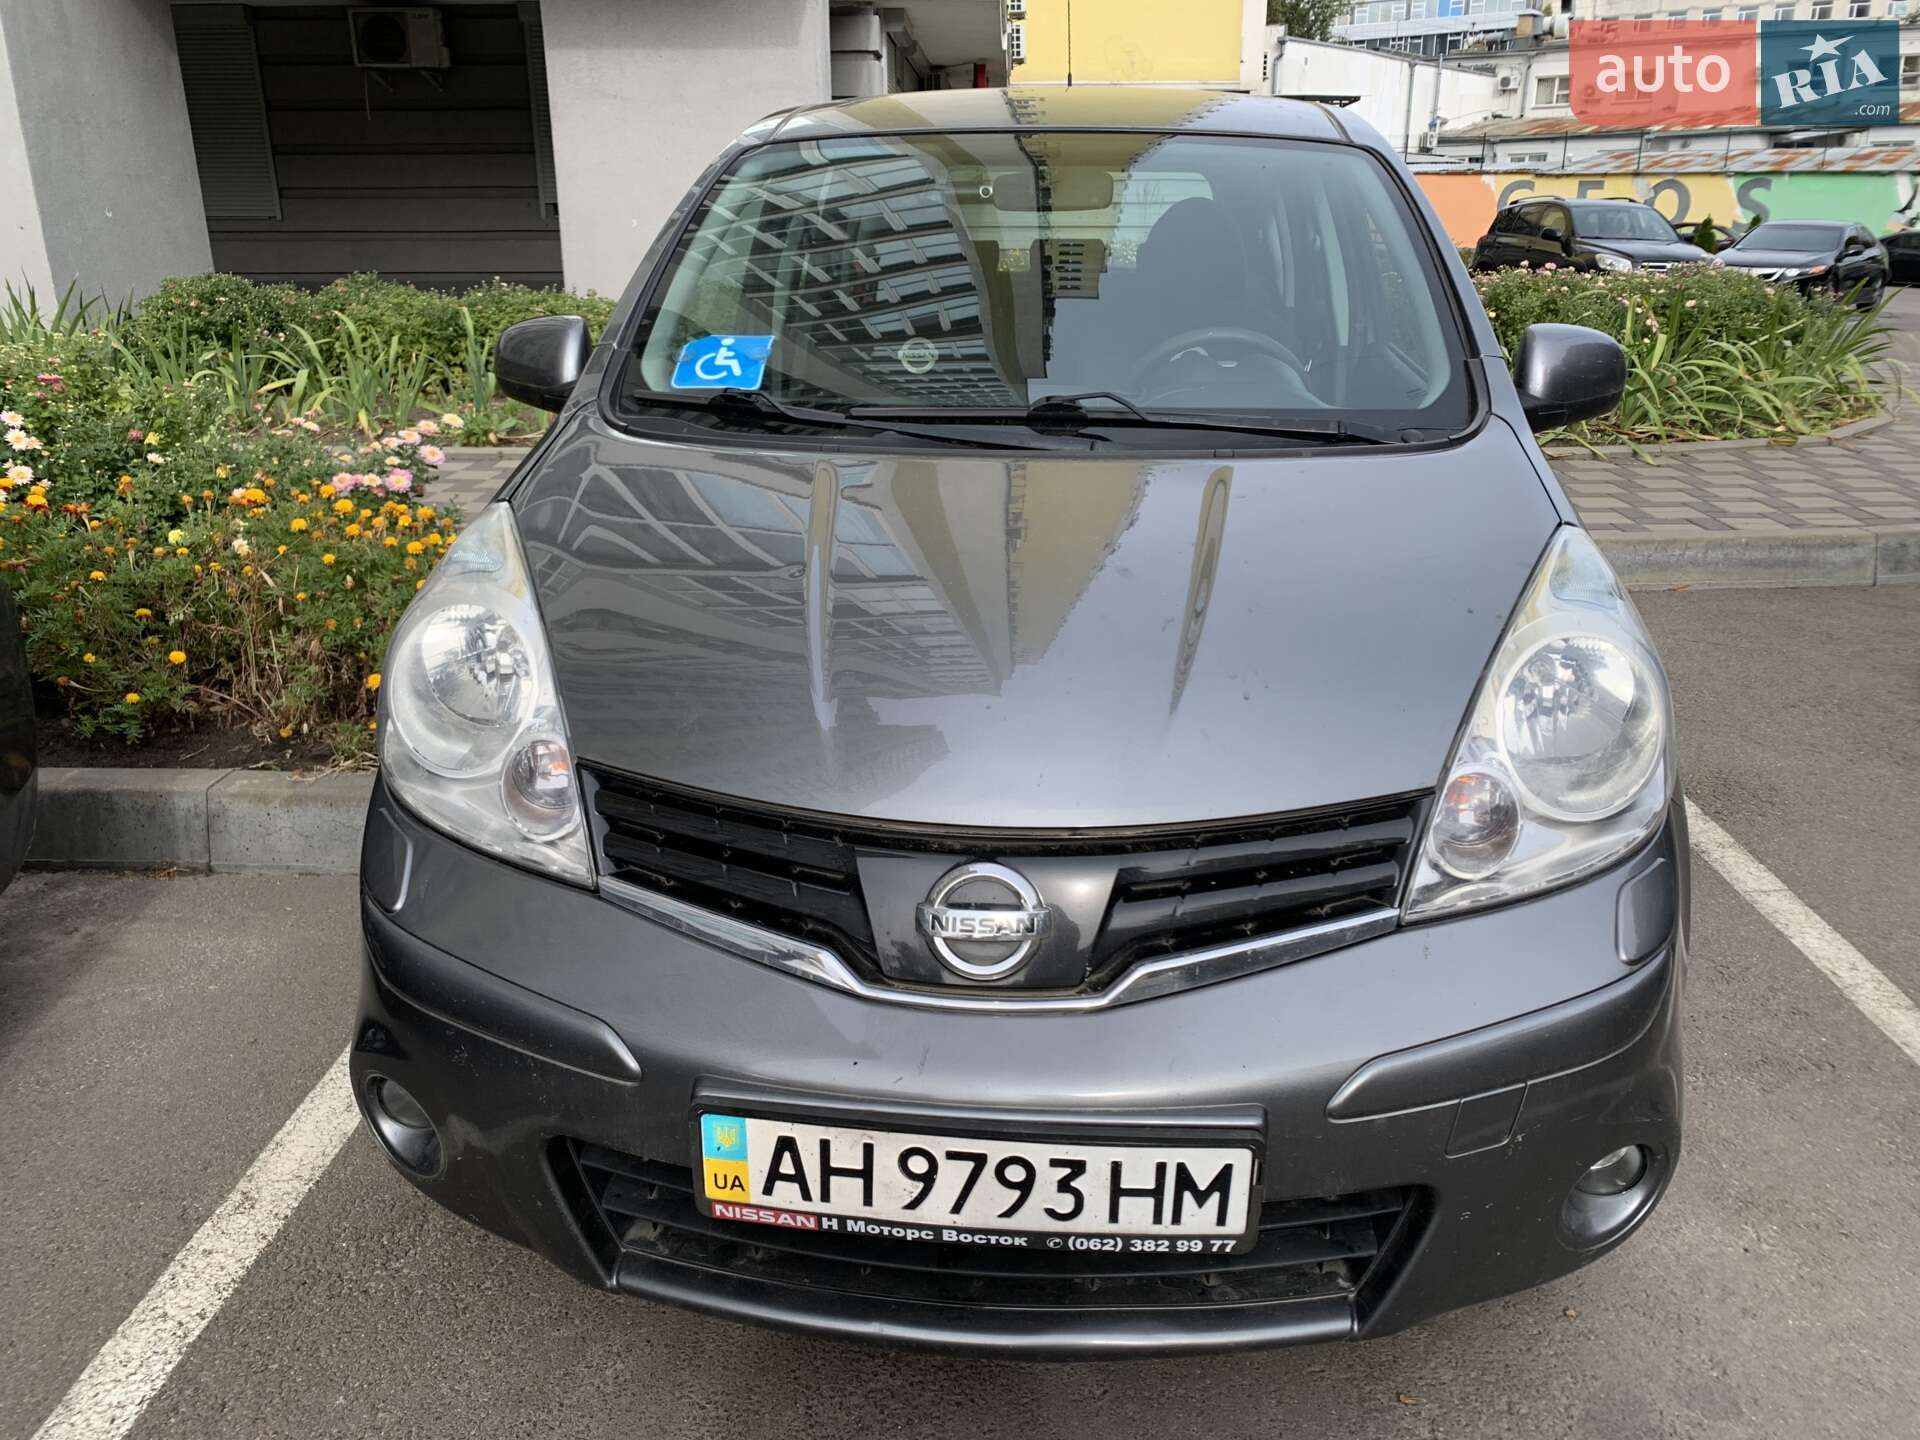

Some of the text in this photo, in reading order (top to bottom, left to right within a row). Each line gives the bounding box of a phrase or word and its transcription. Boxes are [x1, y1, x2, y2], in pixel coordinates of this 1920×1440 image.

[929, 914, 1038, 935] NISSAN
[713, 1172, 746, 1192] UA
[762, 1135, 1234, 1227] AH 9793 HM
[713, 1203, 816, 1229] NISSAN
[846, 1219, 935, 1241] Моторс
[942, 1229, 1028, 1247] Восток
[1067, 1235, 1123, 1252] (062)
[1129, 1238, 1170, 1252] 382
[1176, 1239, 1204, 1252] 99
[1209, 1239, 1237, 1252] 77
